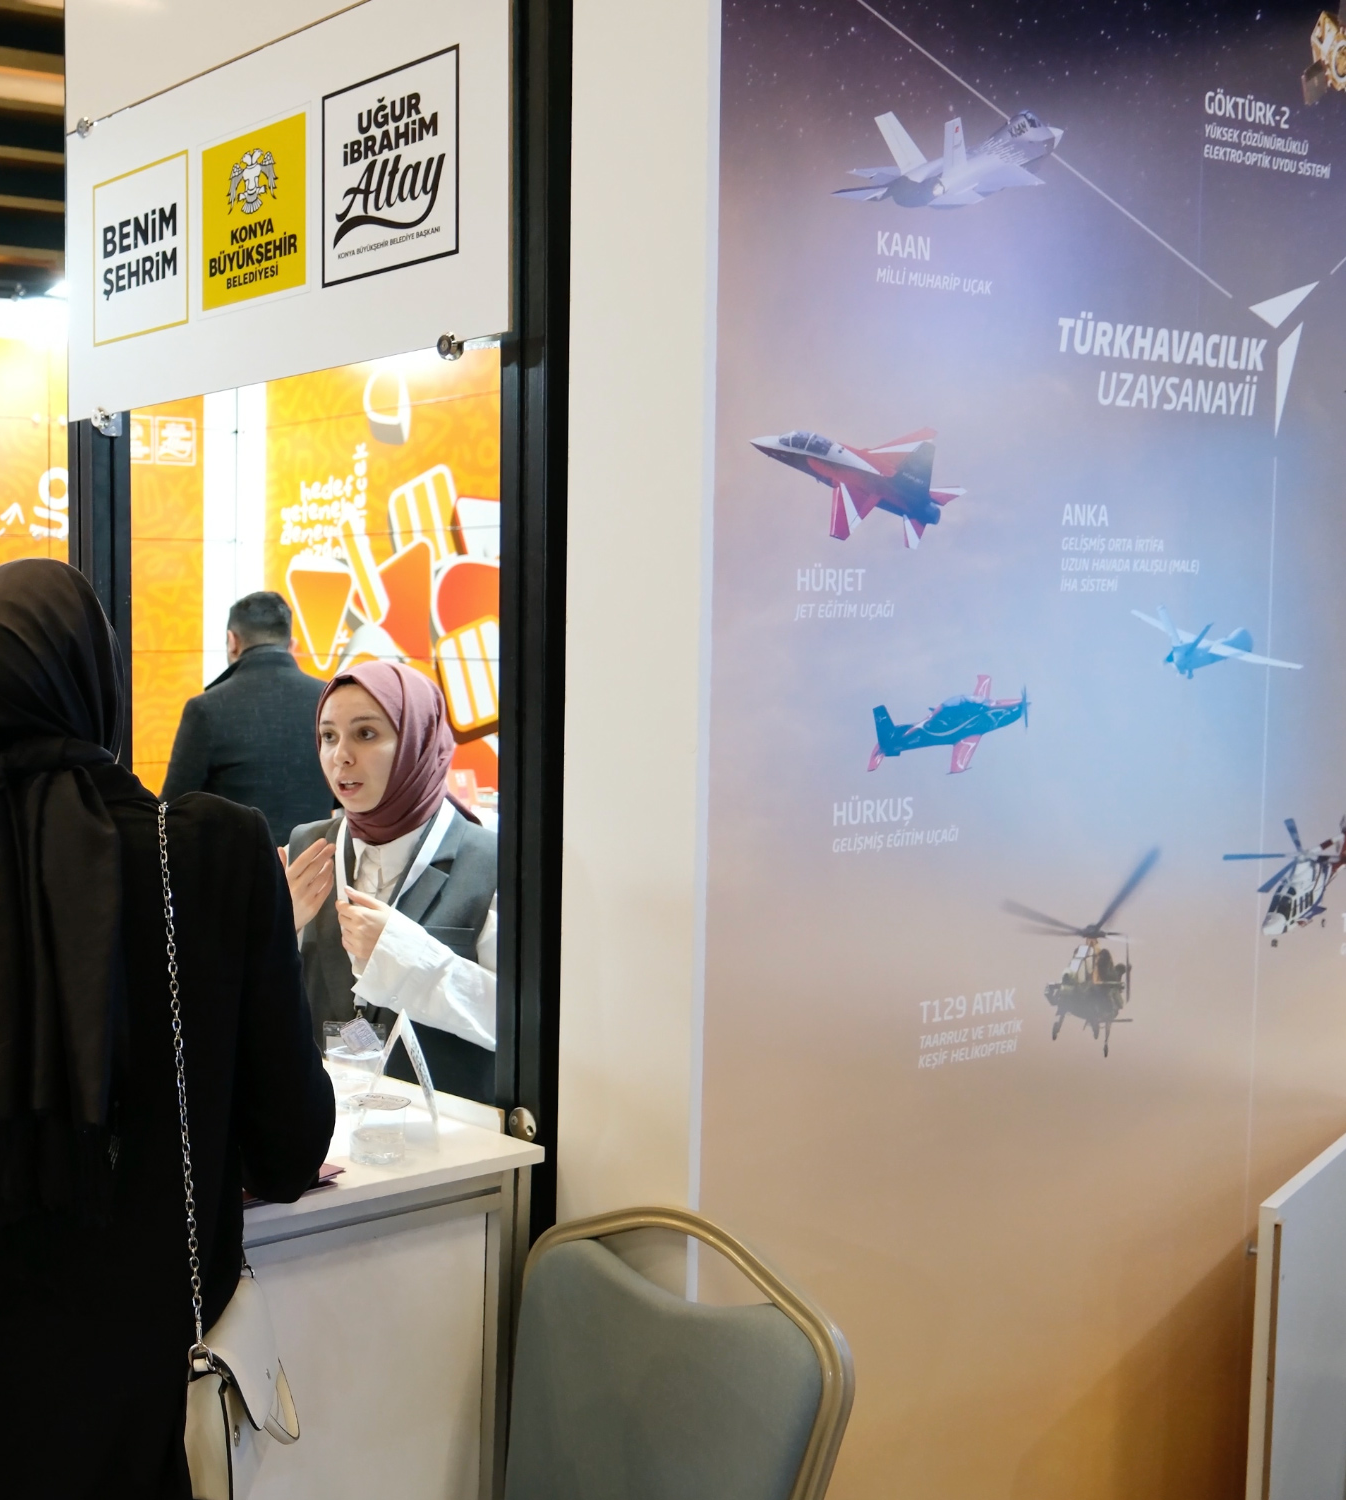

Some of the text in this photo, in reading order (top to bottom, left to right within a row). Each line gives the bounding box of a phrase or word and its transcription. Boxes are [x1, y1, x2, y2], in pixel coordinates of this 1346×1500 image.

[358, 92, 421, 134] UĞUR
[1205, 88, 1290, 129] GÖKTÜRK-2
[1204, 122, 1309, 156] YÜKSEK ÇÖZÜNÜRLÜKLÜ
[1204, 144, 1331, 179] ELEKTRO-OPTİK UYDU SİSTEMİ
[333, 153, 446, 249] Altay
[230, 218, 274, 245] KONYA
[337, 226, 441, 260] KONYA BÜYÜKŞEHİR BELEDİYE BAŞKANI
[877, 230, 931, 261] KAAN
[209, 232, 298, 278] BÜYÜKŞEHİR
[226, 261, 279, 289] BELEDİYESİ
[876, 265, 992, 296] MİLLİ MUHARİP UÇAK
[300, 475, 354, 501] hedef
[1062, 503, 1109, 527] ANKA
[1061, 534, 1164, 554] GELİŞMİŞ ORTA İRTİFA
[797, 563, 866, 596] HÜRJET
[1061, 558, 1200, 575] UZUN HAVADA KALIŞLI (MALE)
[1060, 575, 1118, 591] İHA SİSTEMİ
[794, 600, 894, 621] JET EĞİTİM UÇAĞI
[833, 795, 914, 826] HÜRKUŞ
[832, 824, 959, 854] GELİŞMİŞ EĞİTİM UÇAĞI
[920, 987, 1016, 1024] T129 ATAK
[920, 1017, 1024, 1049] TAARRUZ VE TAKTİK
[918, 1035, 1018, 1069] KEŞİF HELİKOPTERİ
